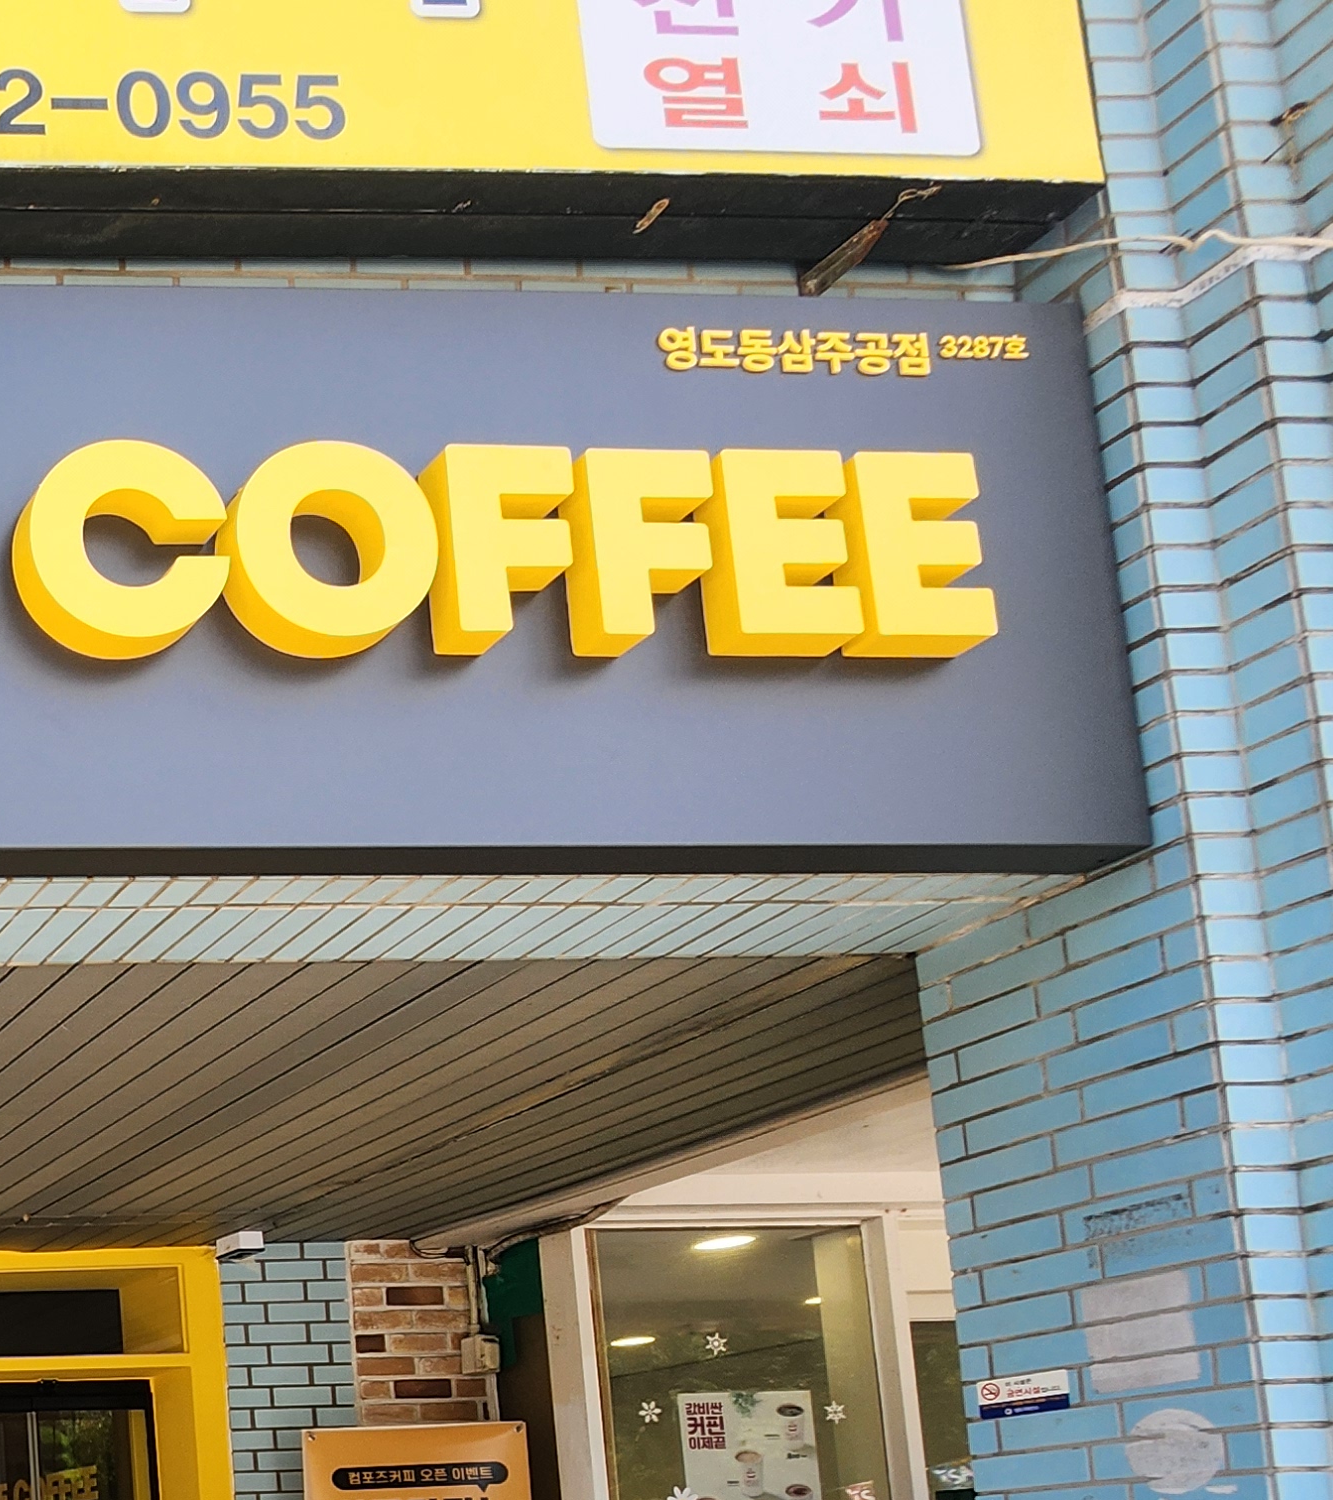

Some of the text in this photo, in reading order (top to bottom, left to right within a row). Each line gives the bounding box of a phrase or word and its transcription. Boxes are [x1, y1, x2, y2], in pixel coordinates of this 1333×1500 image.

[657, 326, 1030, 376] 영도동삼주공점 3287호
[11, 438, 999, 660] COFFEE
[685, 1402, 723, 1415] 값비싼
[687, 1416, 725, 1436] 커핀
[689, 1437, 726, 1450] 이제끝
[348, 1466, 493, 1485] 컴포즈커피 오픈 이벤트
